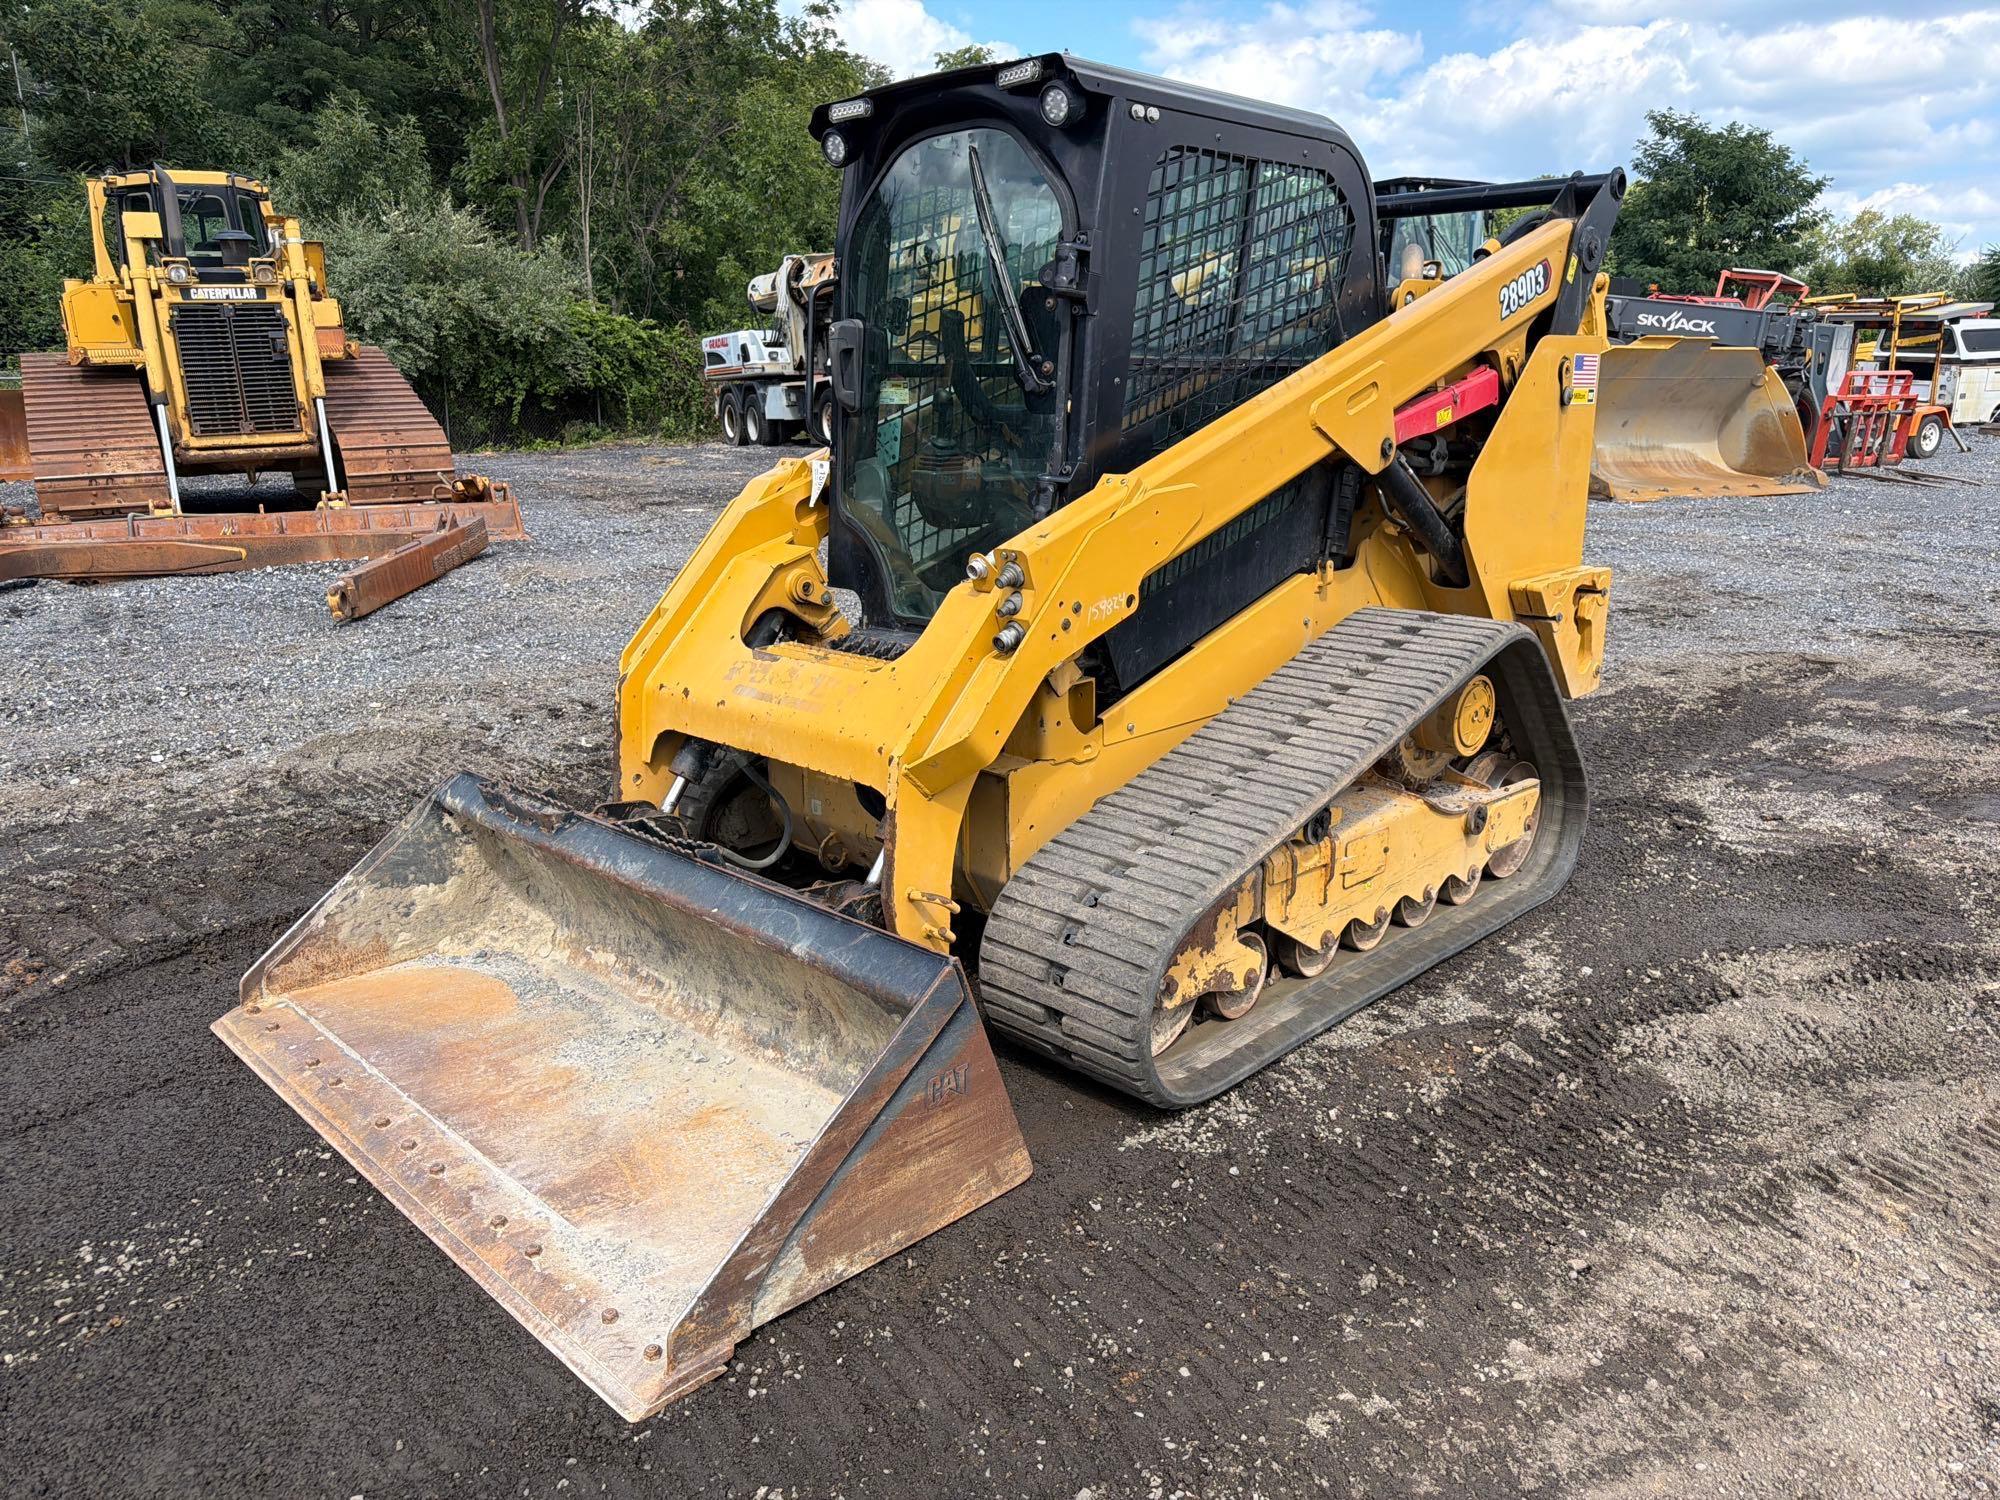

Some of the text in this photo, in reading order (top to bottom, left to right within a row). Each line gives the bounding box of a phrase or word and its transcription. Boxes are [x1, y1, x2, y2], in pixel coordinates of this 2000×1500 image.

[190, 288, 257, 299] CATERPILLAR
[1499, 263, 1546, 319] 289D3
[1636, 310, 1716, 333] SKYJACK
[1087, 592, 1126, 626] 159824
[927, 1063, 969, 1109] CAT
